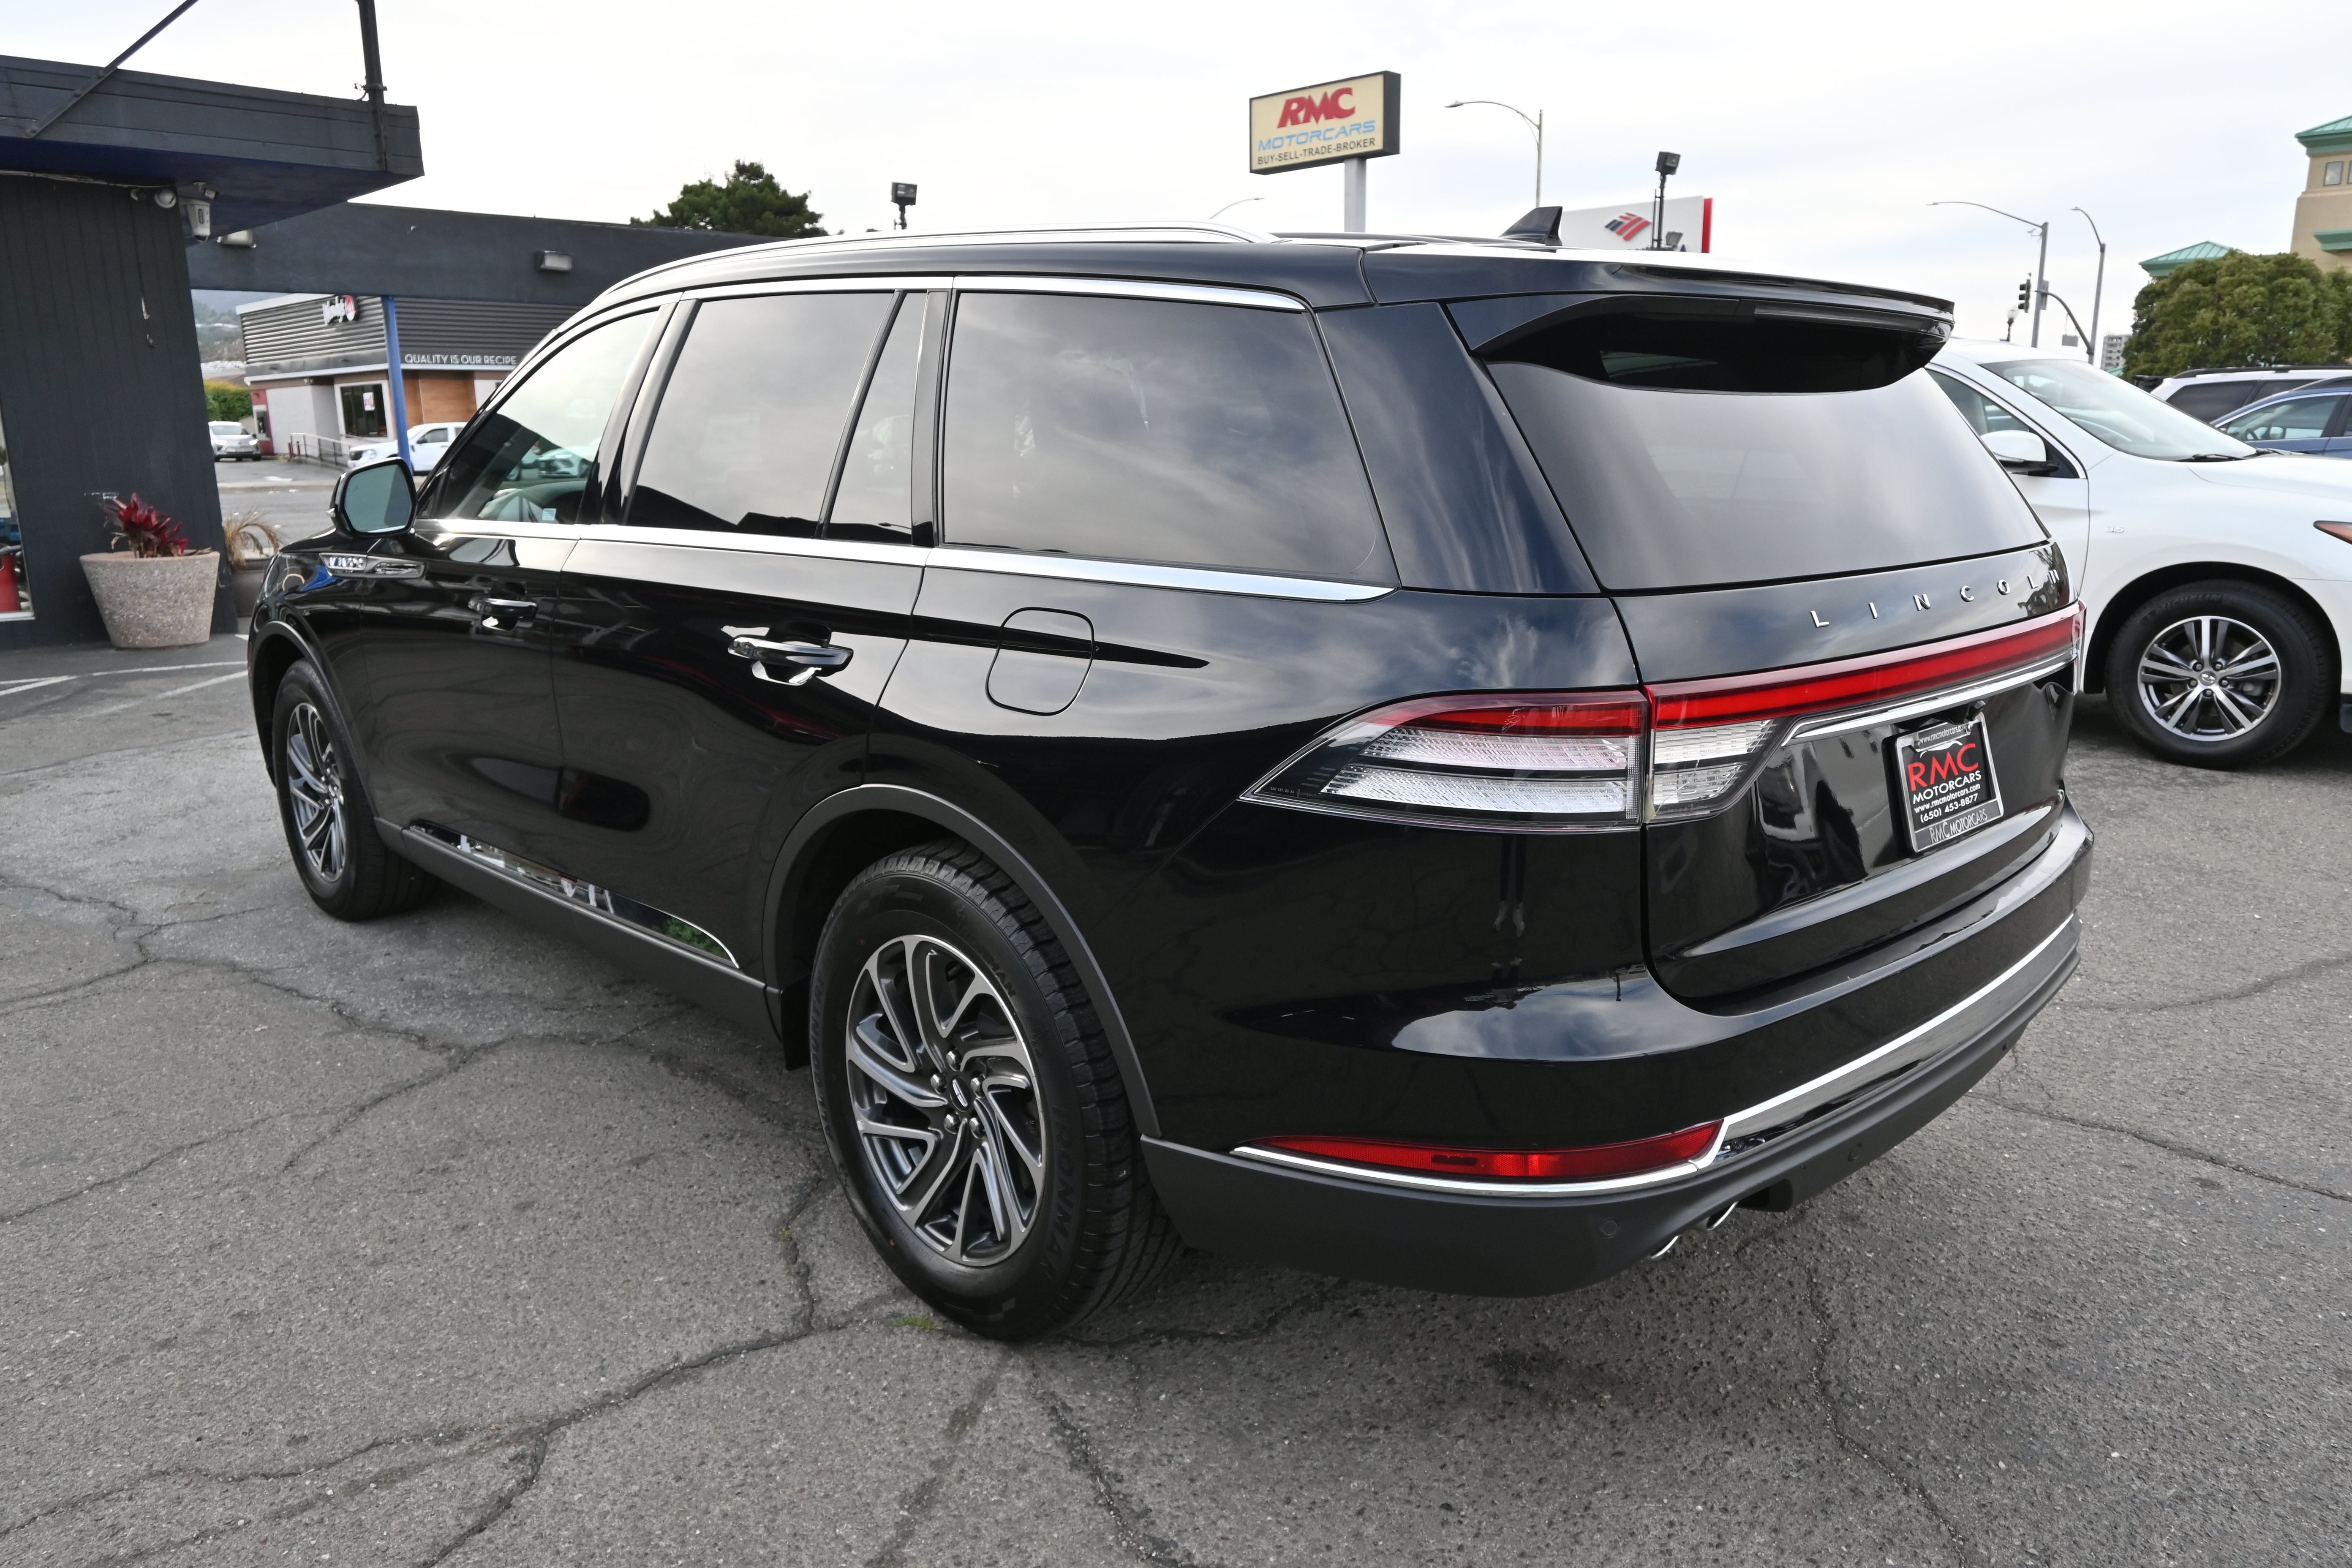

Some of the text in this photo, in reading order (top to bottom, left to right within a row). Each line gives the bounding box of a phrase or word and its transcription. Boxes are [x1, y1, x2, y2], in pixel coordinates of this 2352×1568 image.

[1277, 87, 1356, 128] RMC
[1258, 120, 1376, 151] MOTORCARS
[1258, 137, 1375, 165] BUY-SELL-TRADE-BROKER
[404, 354, 517, 365] QUALITY IS OUR RECIPE
[1810, 569, 2061, 628] LINCOLN
[1908, 743, 1979, 792] RMC
[1913, 770, 1982, 804] MOTORCARS
[1914, 783, 1981, 814] www.rmcmotorcars.com
[1920, 793, 1979, 823] (650) 453-8877
[1929, 808, 1988, 844] RMC MOTORCARS
